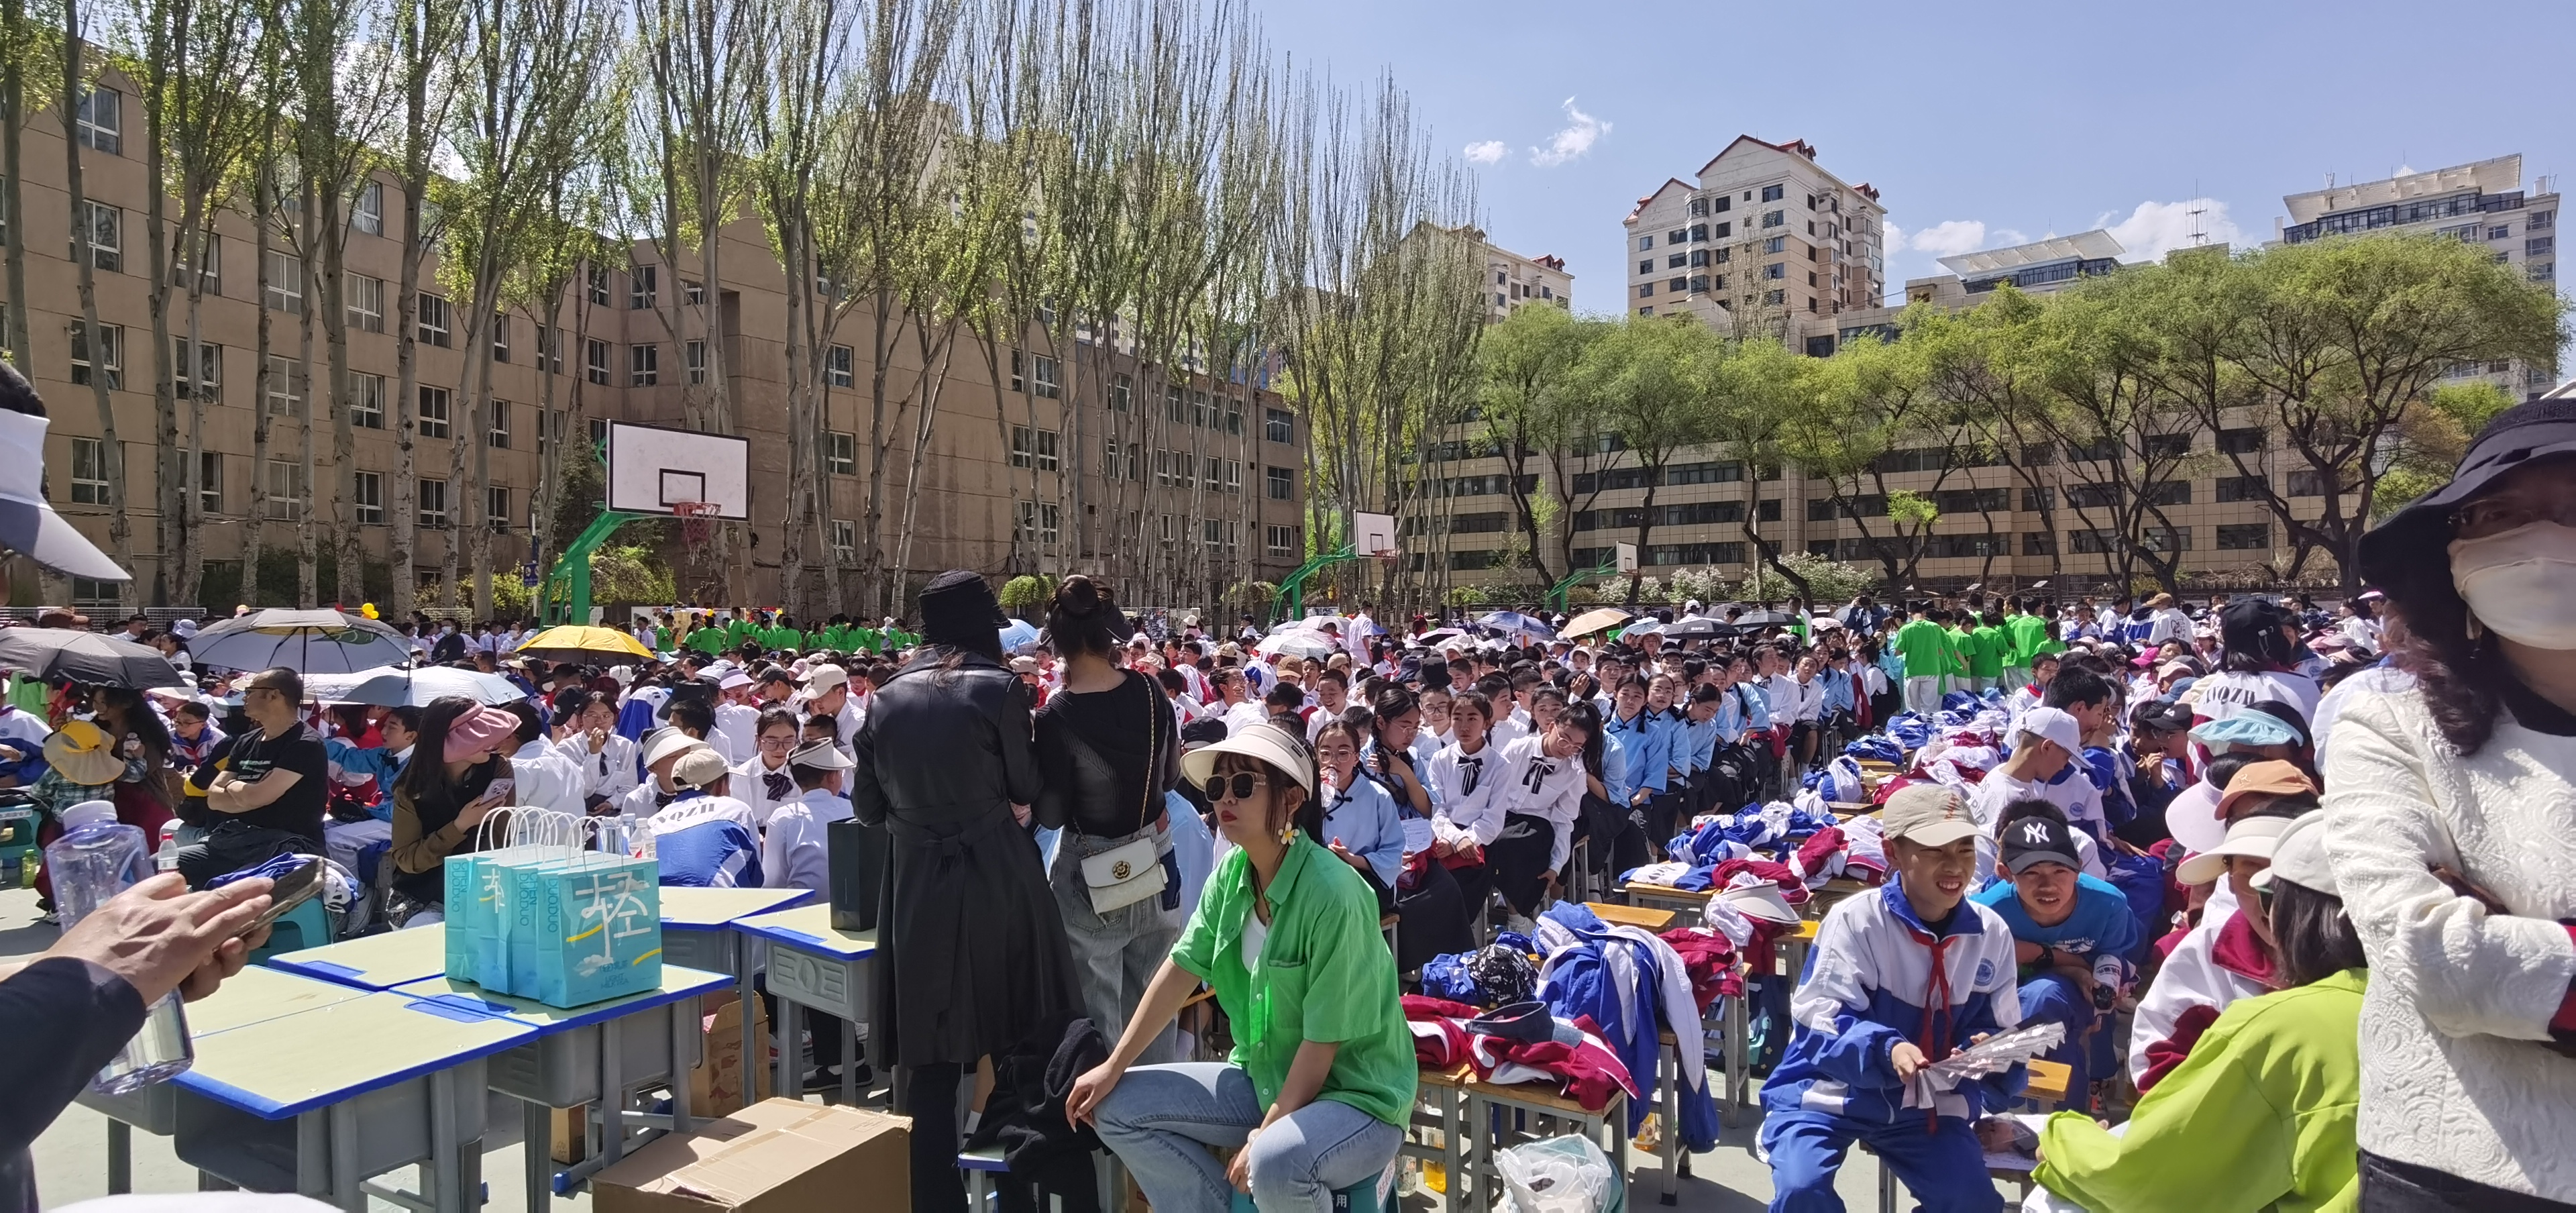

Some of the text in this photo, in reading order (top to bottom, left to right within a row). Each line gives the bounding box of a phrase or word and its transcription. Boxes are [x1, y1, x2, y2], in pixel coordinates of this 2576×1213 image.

[2023, 822, 2050, 843] NY
[575, 872, 651, 959] 轻
[1330, 1194, 1347, 1208] 用
